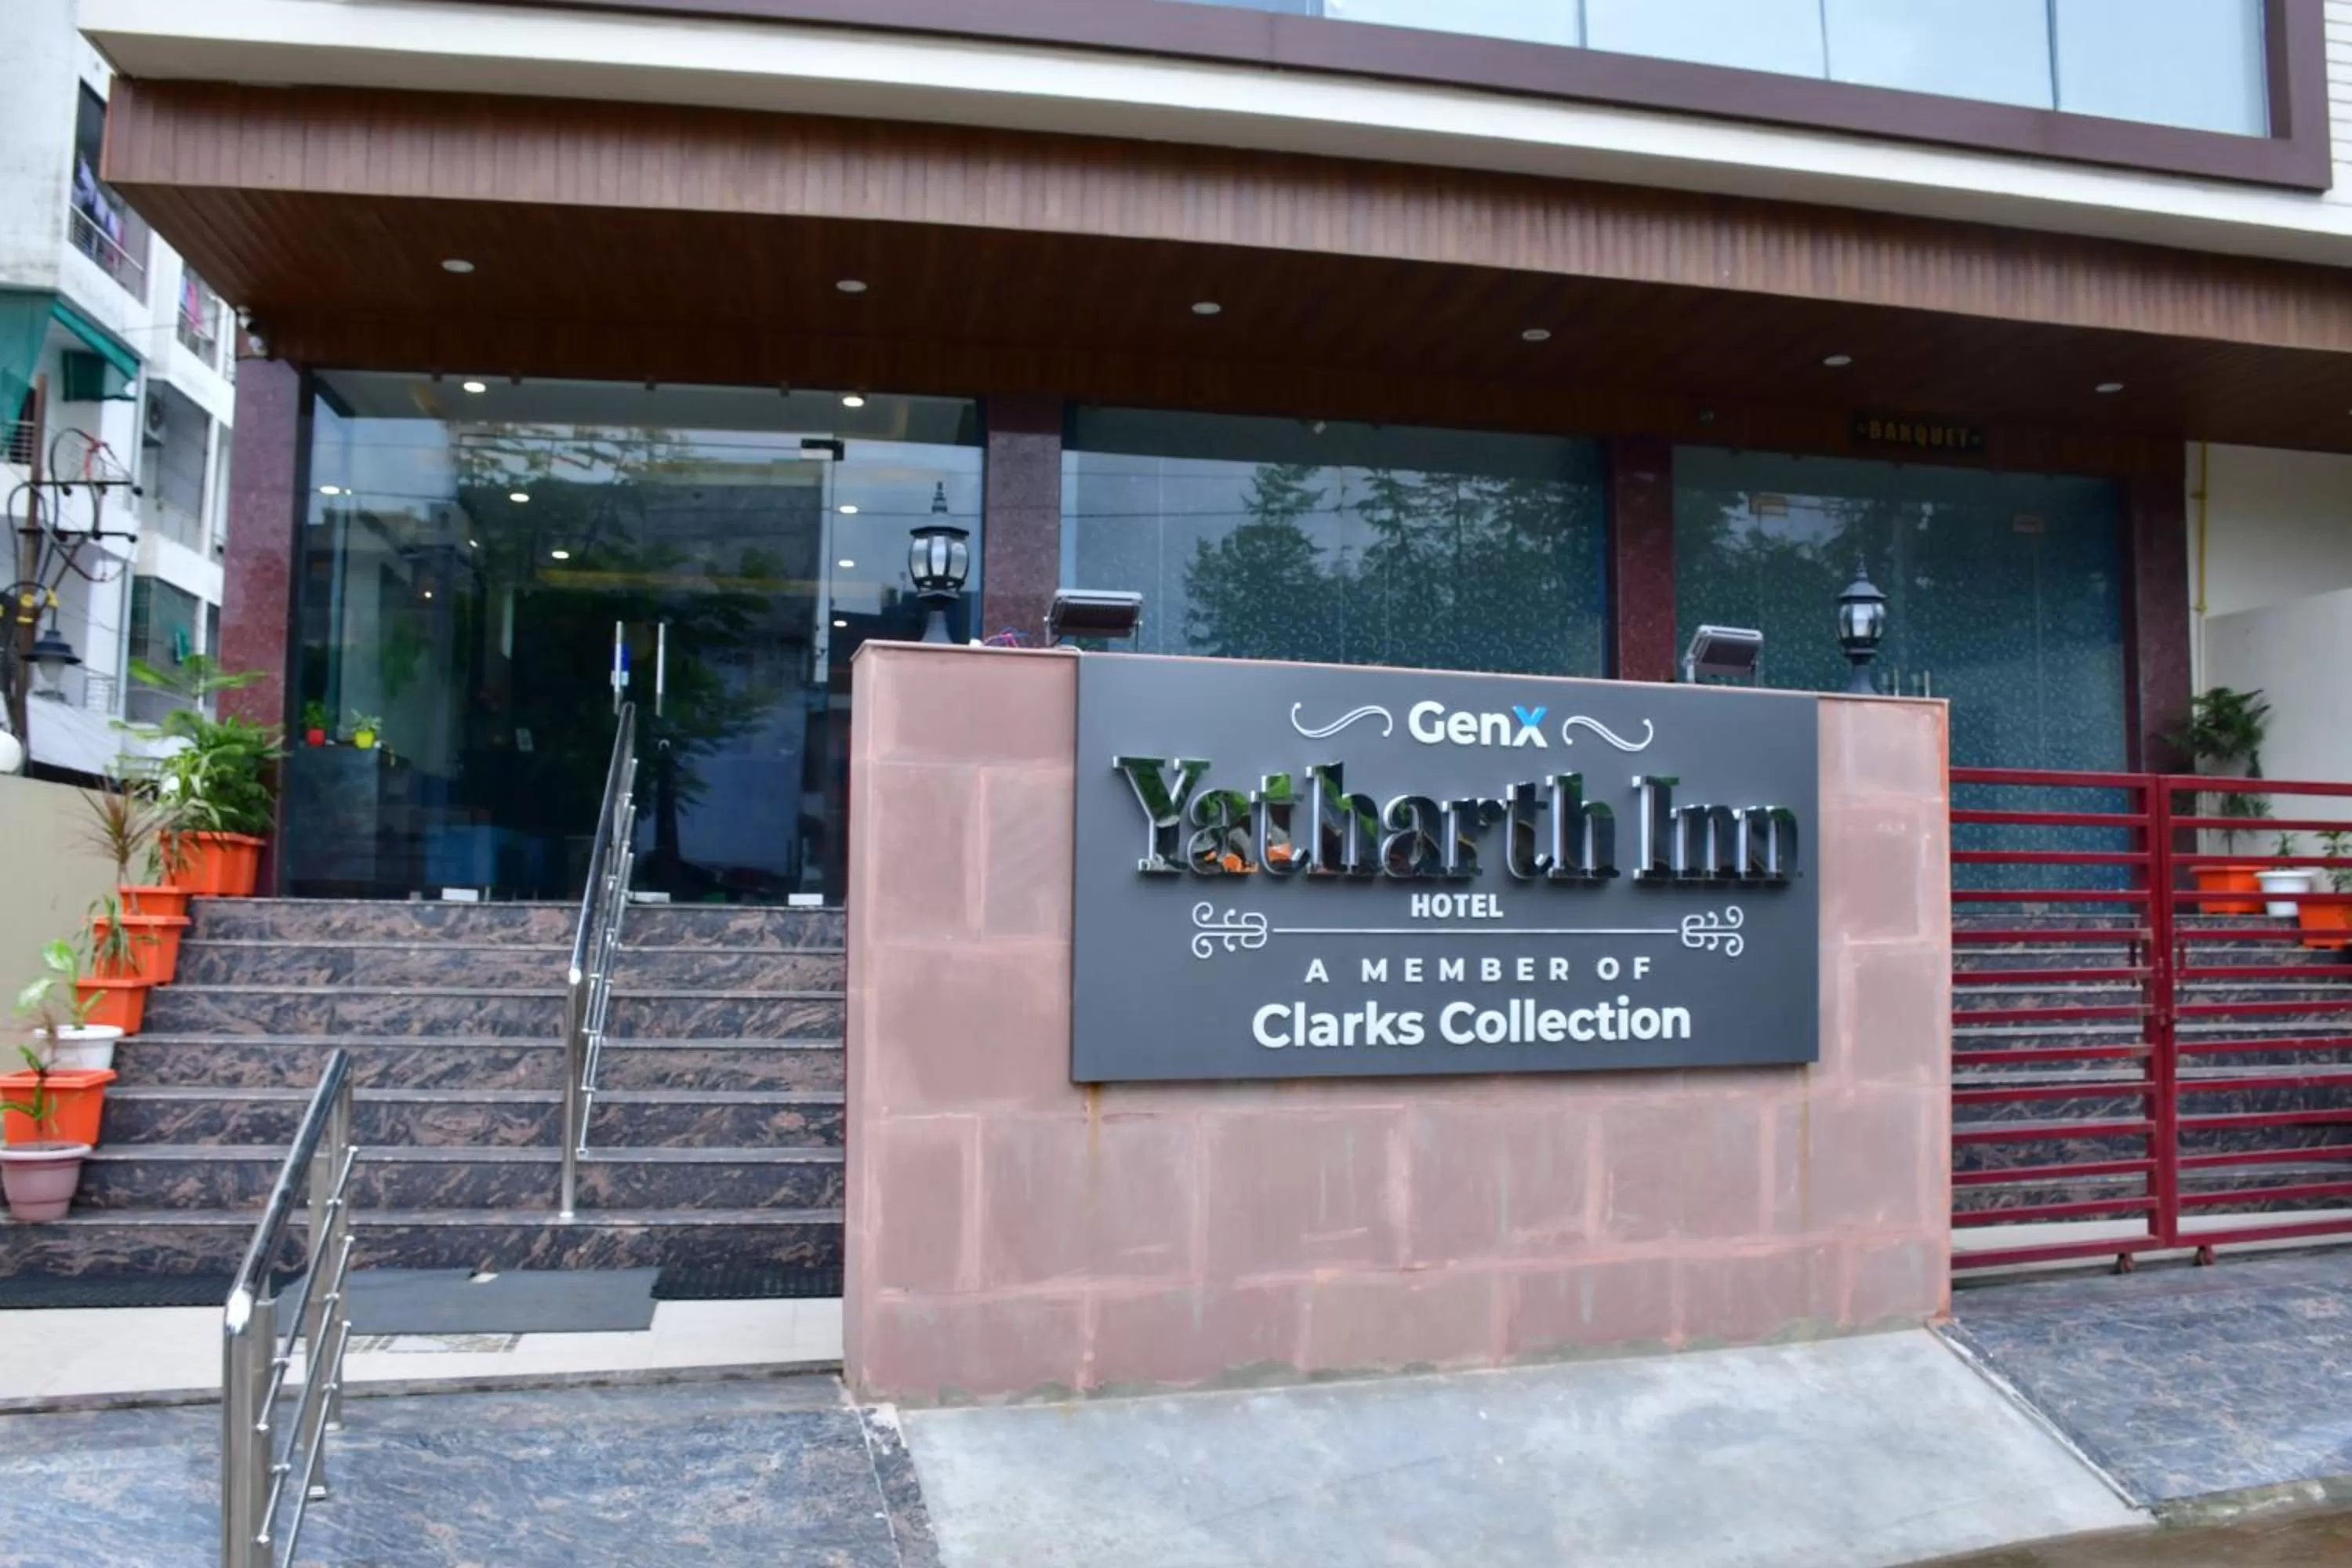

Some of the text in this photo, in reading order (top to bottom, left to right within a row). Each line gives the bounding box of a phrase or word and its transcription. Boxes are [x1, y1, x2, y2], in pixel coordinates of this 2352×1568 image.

[1868, 420, 1969, 447] BANQUET
[1409, 700, 1548, 748] GenX
[1112, 755, 1801, 880] Yatharth Inn
[1411, 894, 1503, 918] HOTEL
[1305, 956, 1651, 982] A MEMBER OF
[1252, 995, 1691, 1048] Clarks Collection
